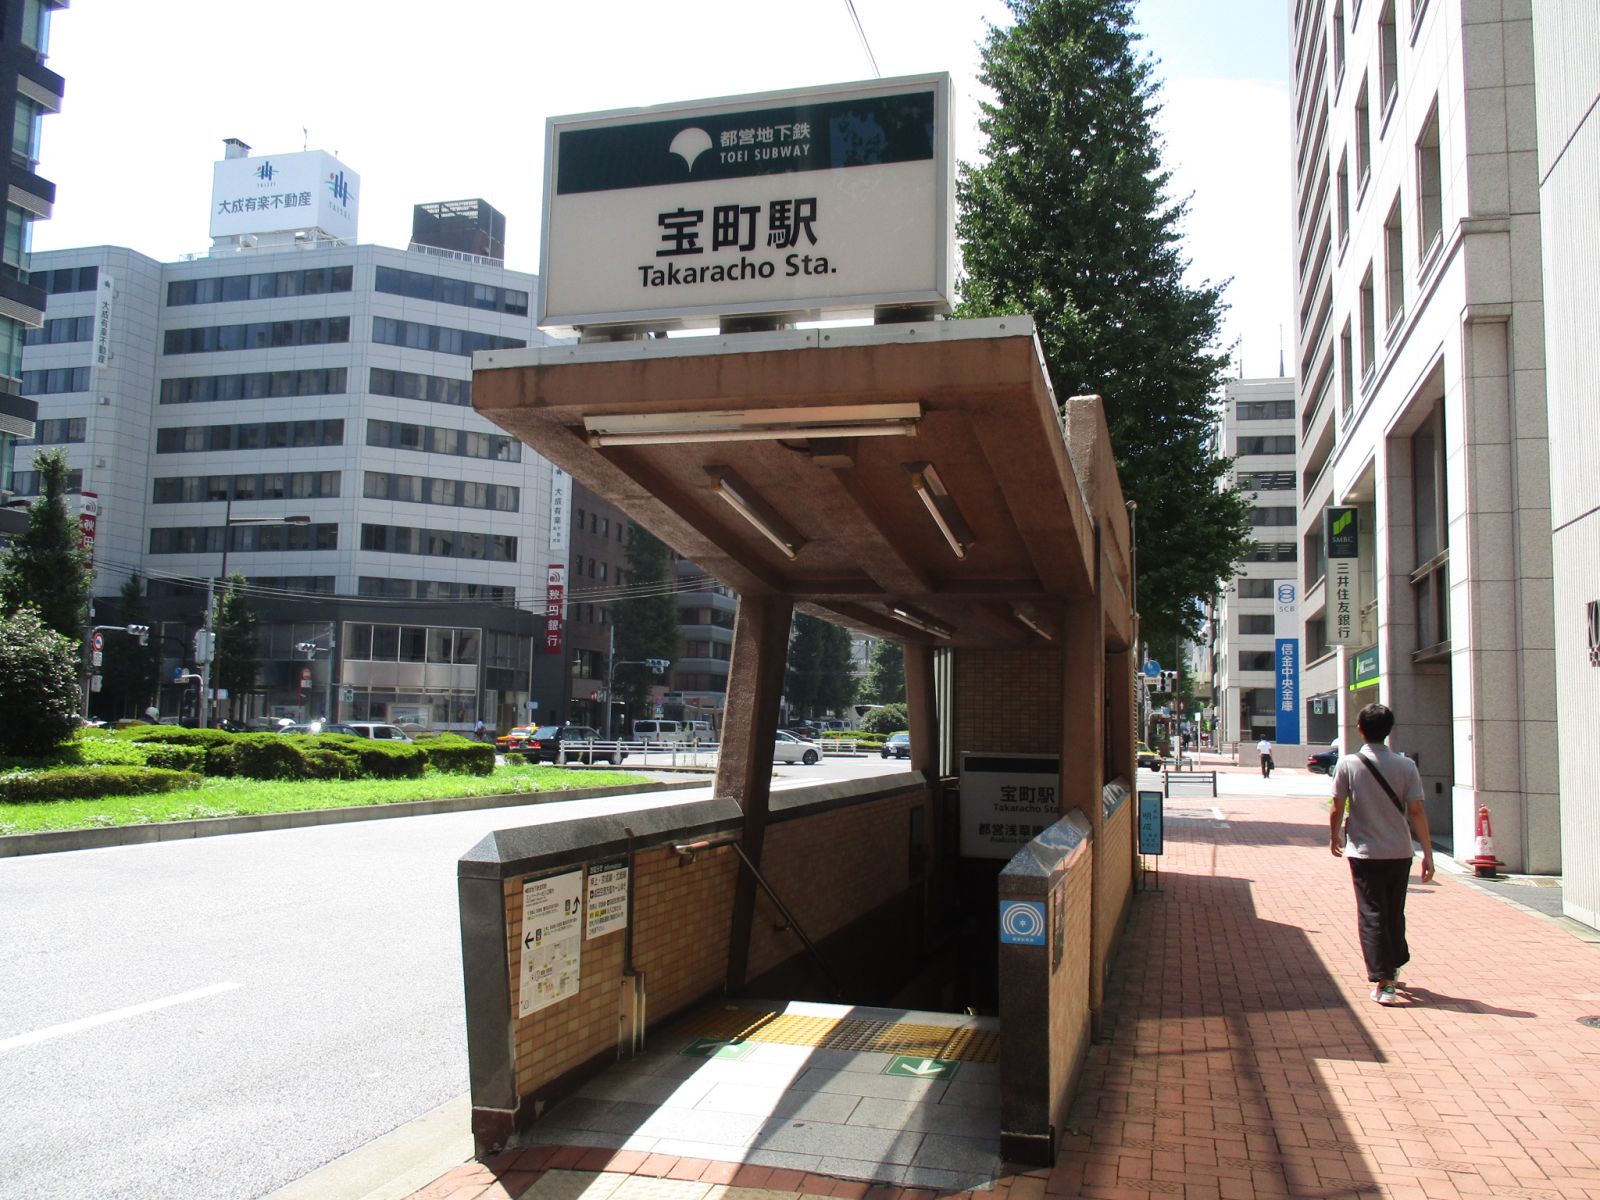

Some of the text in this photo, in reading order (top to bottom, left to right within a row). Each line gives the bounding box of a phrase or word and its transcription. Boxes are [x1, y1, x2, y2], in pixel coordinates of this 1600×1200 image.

[720, 122, 811, 147] 都営地下鉄
[720, 144, 810, 164] TOEI SUBWAY
[218, 192, 312, 215] 大成有楽不動産
[656, 197, 818, 257] 宝町駅
[638, 253, 837, 287] Takaracho Sta.
[1337, 562, 1350, 638] 三井住友銀行
[547, 589, 560, 647] 秋田銀行
[1281, 643, 1294, 711] 信金中央金庫
[993, 803, 1041, 814] Takaracho
[1000, 785, 1055, 803] 宝町駅
